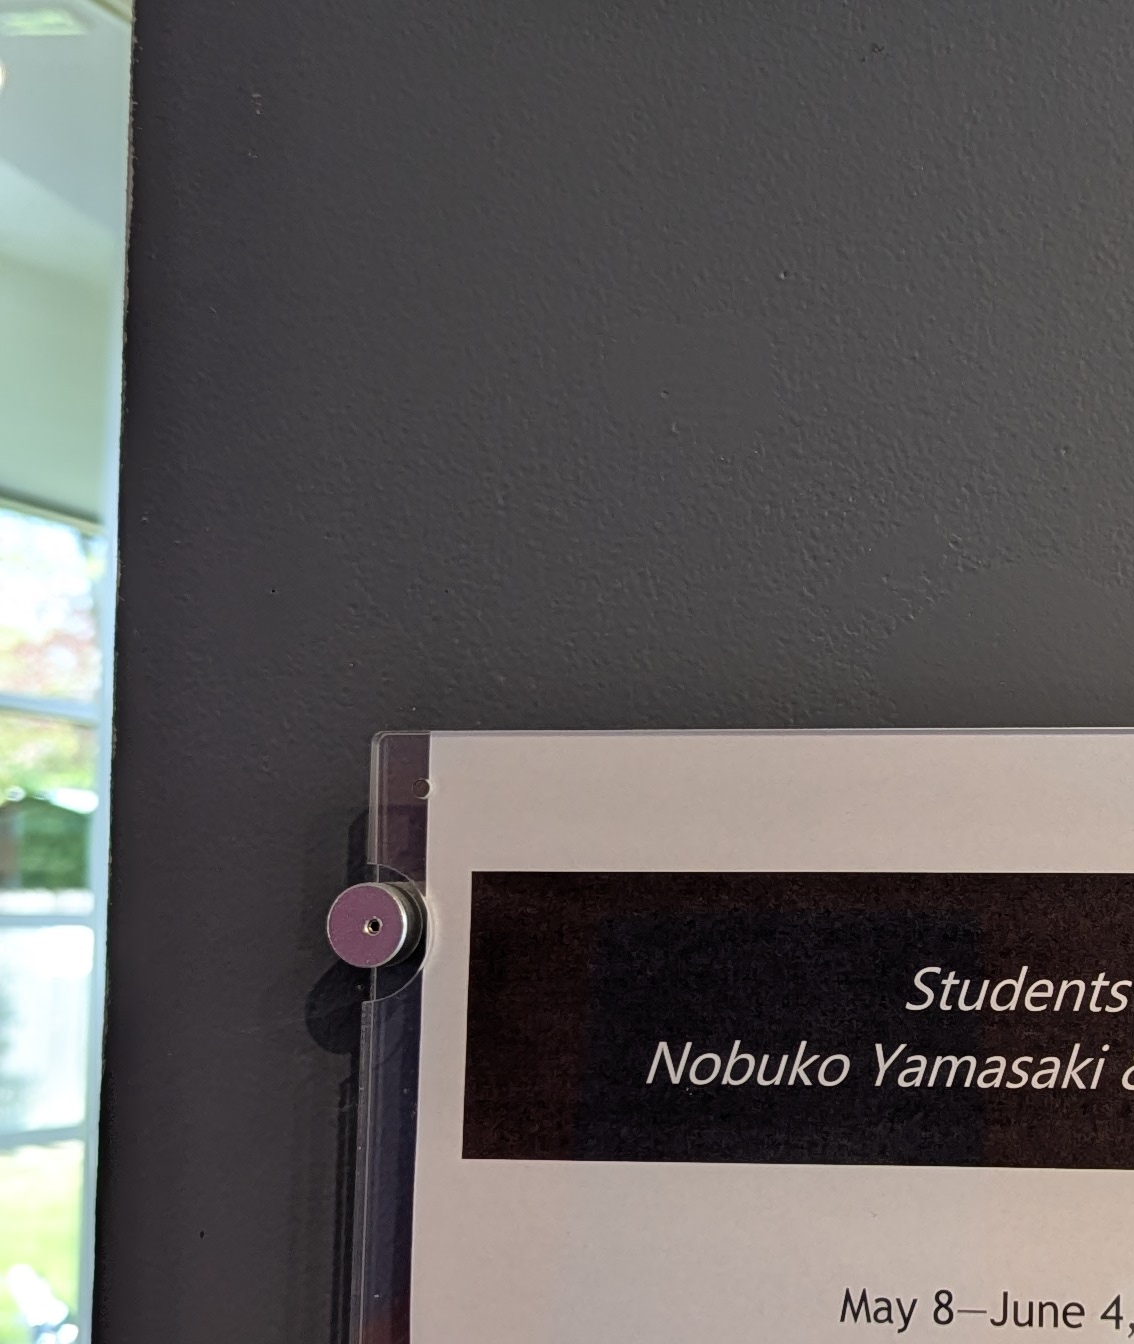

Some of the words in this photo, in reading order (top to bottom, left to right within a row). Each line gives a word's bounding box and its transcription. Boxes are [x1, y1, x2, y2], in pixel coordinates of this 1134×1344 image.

[905, 965, 1133, 1013] Students
[645, 1039, 851, 1087] Nobuko
[874, 1042, 1110, 1090] Yamasaki
[839, 1287, 918, 1334] May
